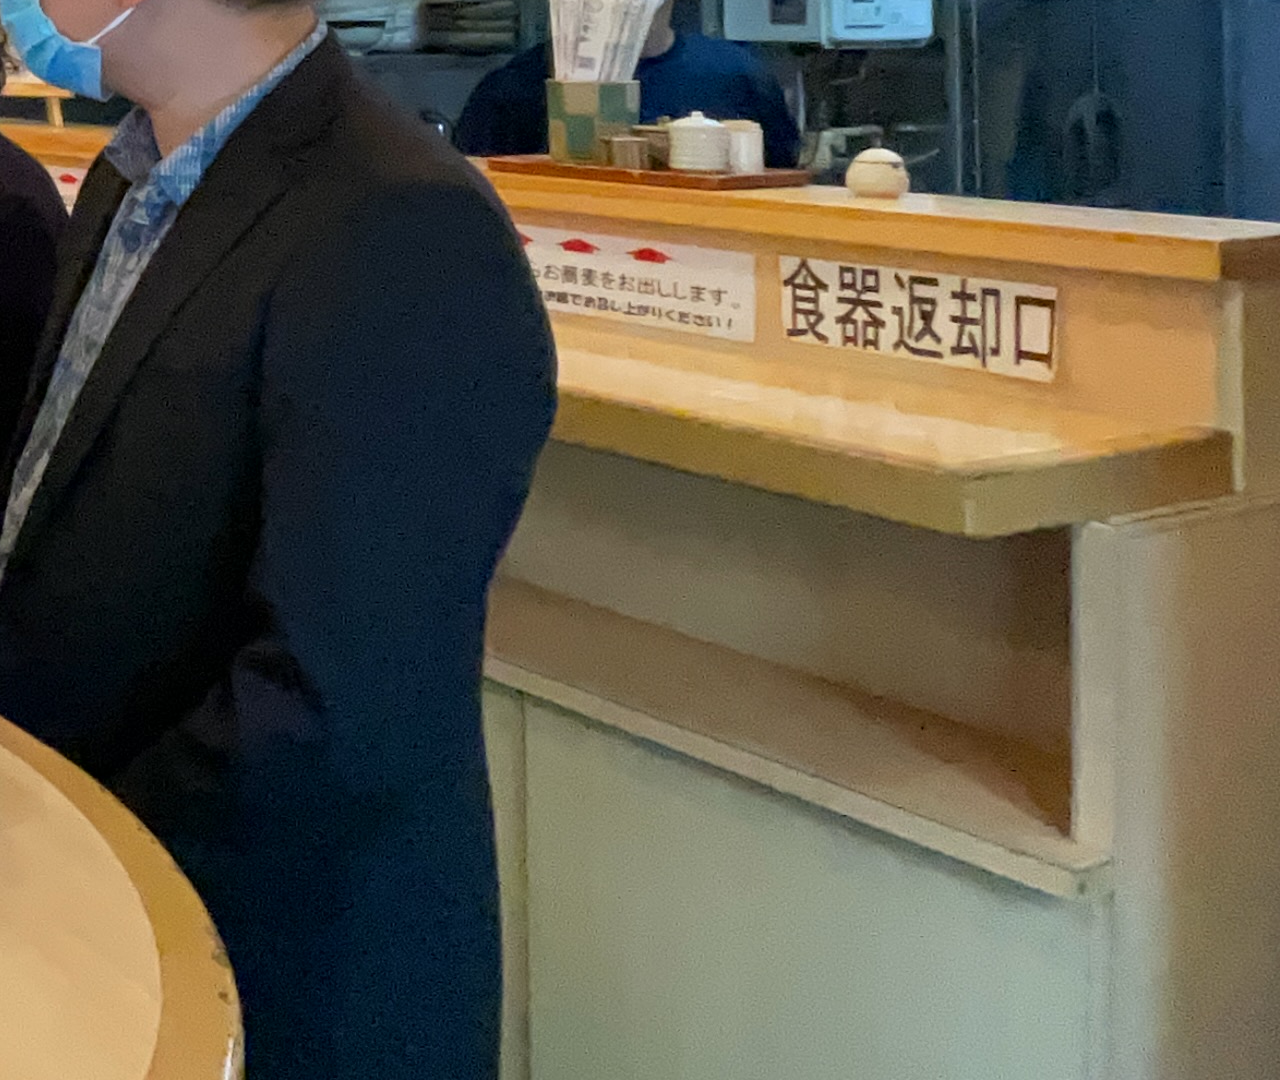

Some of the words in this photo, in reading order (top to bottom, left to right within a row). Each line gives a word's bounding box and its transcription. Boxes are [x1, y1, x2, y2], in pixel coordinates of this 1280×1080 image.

[782, 257, 1057, 370] 食器返却口
